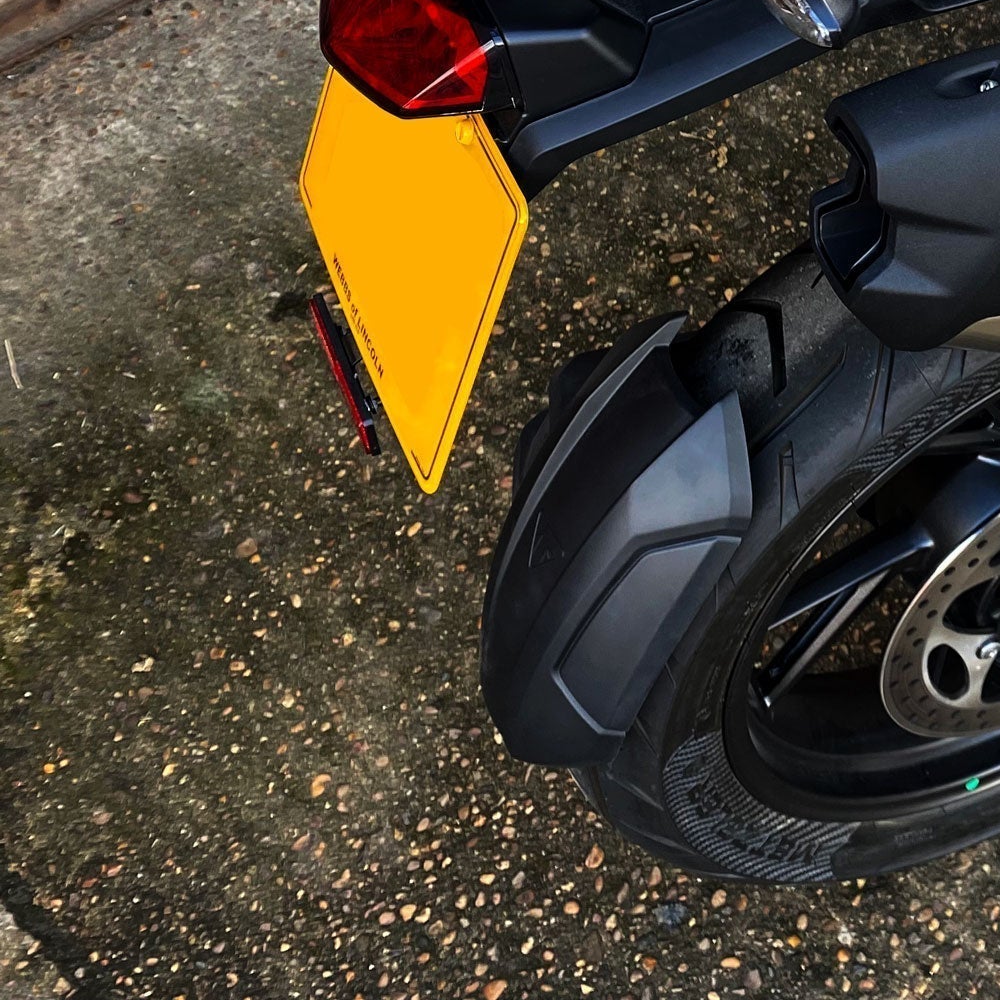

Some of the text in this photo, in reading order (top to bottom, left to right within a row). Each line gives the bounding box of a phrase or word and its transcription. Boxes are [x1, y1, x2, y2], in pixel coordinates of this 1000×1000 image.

[333, 255, 352, 302] WEBBS
[350, 304, 359, 316] of
[357, 316, 384, 379] LINCOLN
